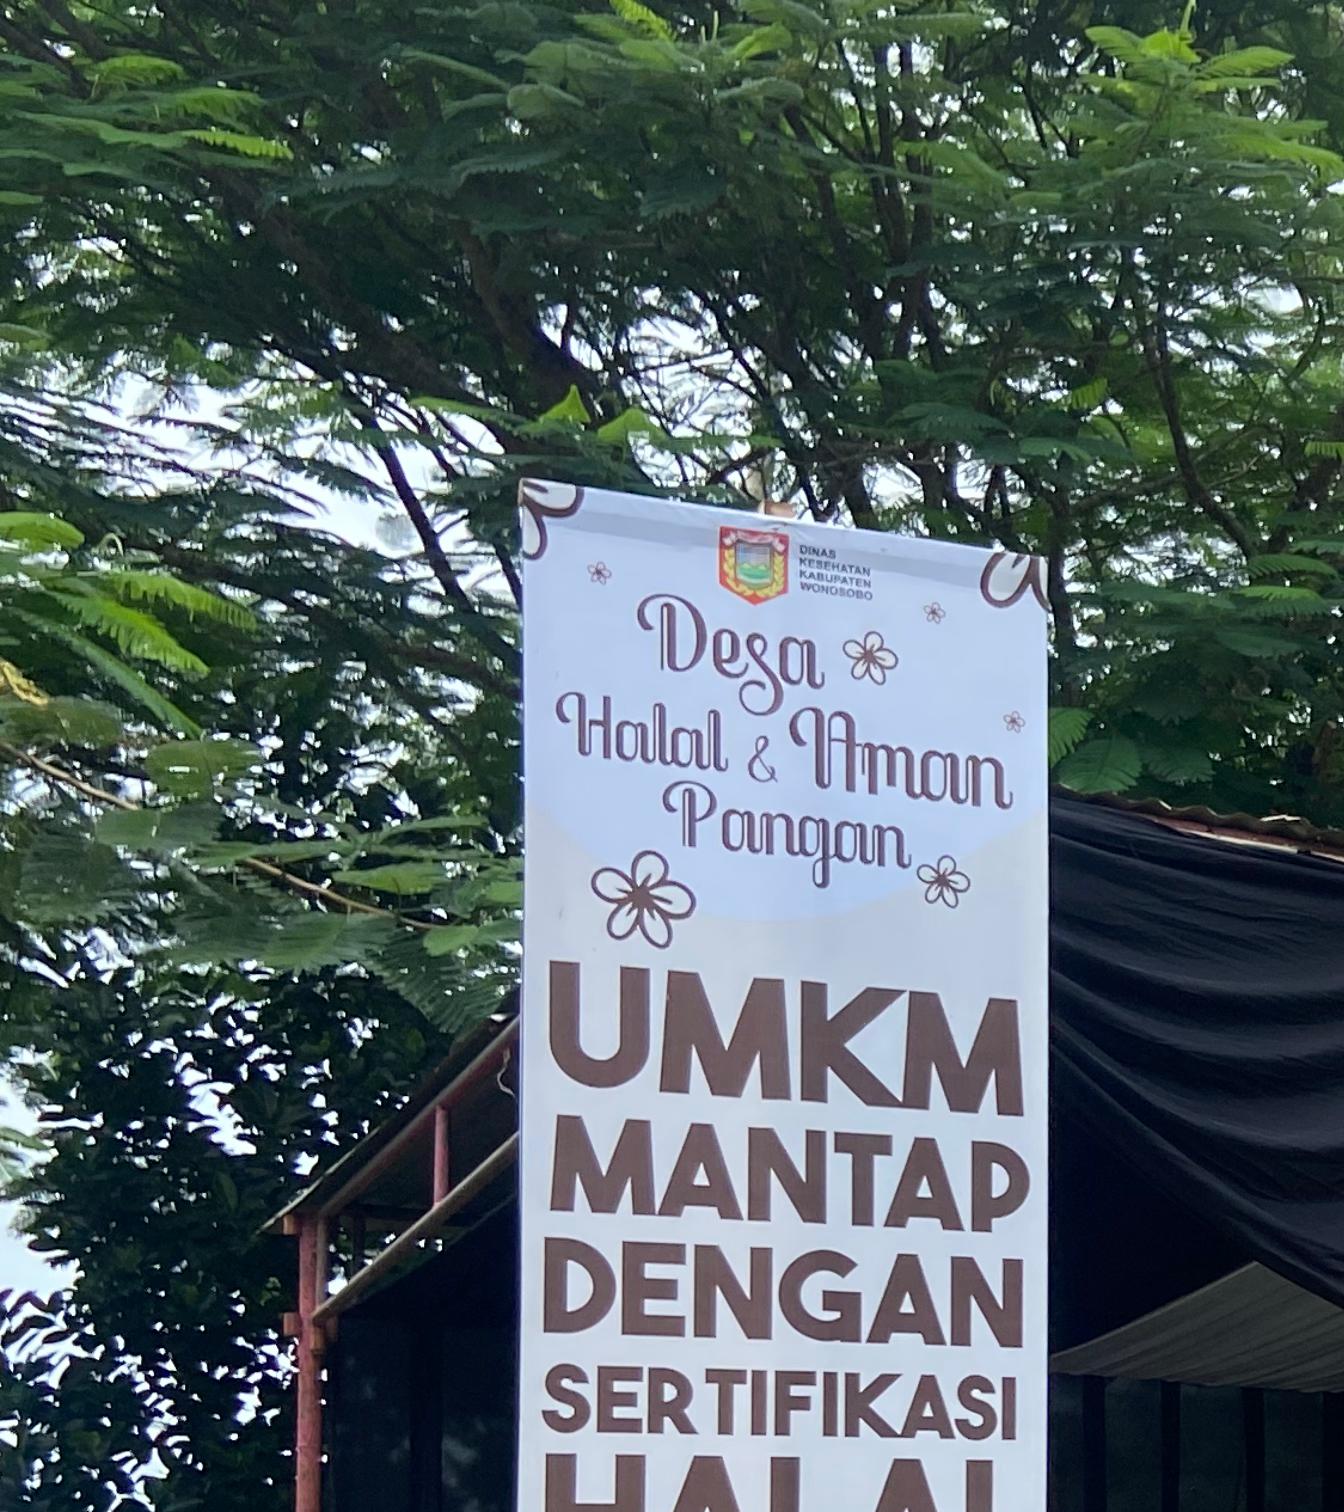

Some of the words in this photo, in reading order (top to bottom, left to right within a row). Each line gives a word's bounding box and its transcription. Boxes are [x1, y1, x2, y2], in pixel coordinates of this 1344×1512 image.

[799, 557, 871, 577] KESEHATAN
[799, 570, 871, 588] KABUPATEN
[800, 544, 836, 559] DINAS
[800, 581, 873, 600] WONOSOBO
[637, 594, 825, 716] Desa
[556, 691, 729, 772] Halal
[748, 735, 778, 782] &
[789, 707, 1013, 810] Aman
[662, 780, 911, 888] Pangan
[549, 960, 1024, 1117] UMKM
[549, 1114, 1031, 1232] MANTAP
[543, 1237, 1024, 1348] DENGAN
[542, 1363, 1016, 1440] SERTIFIKASI
